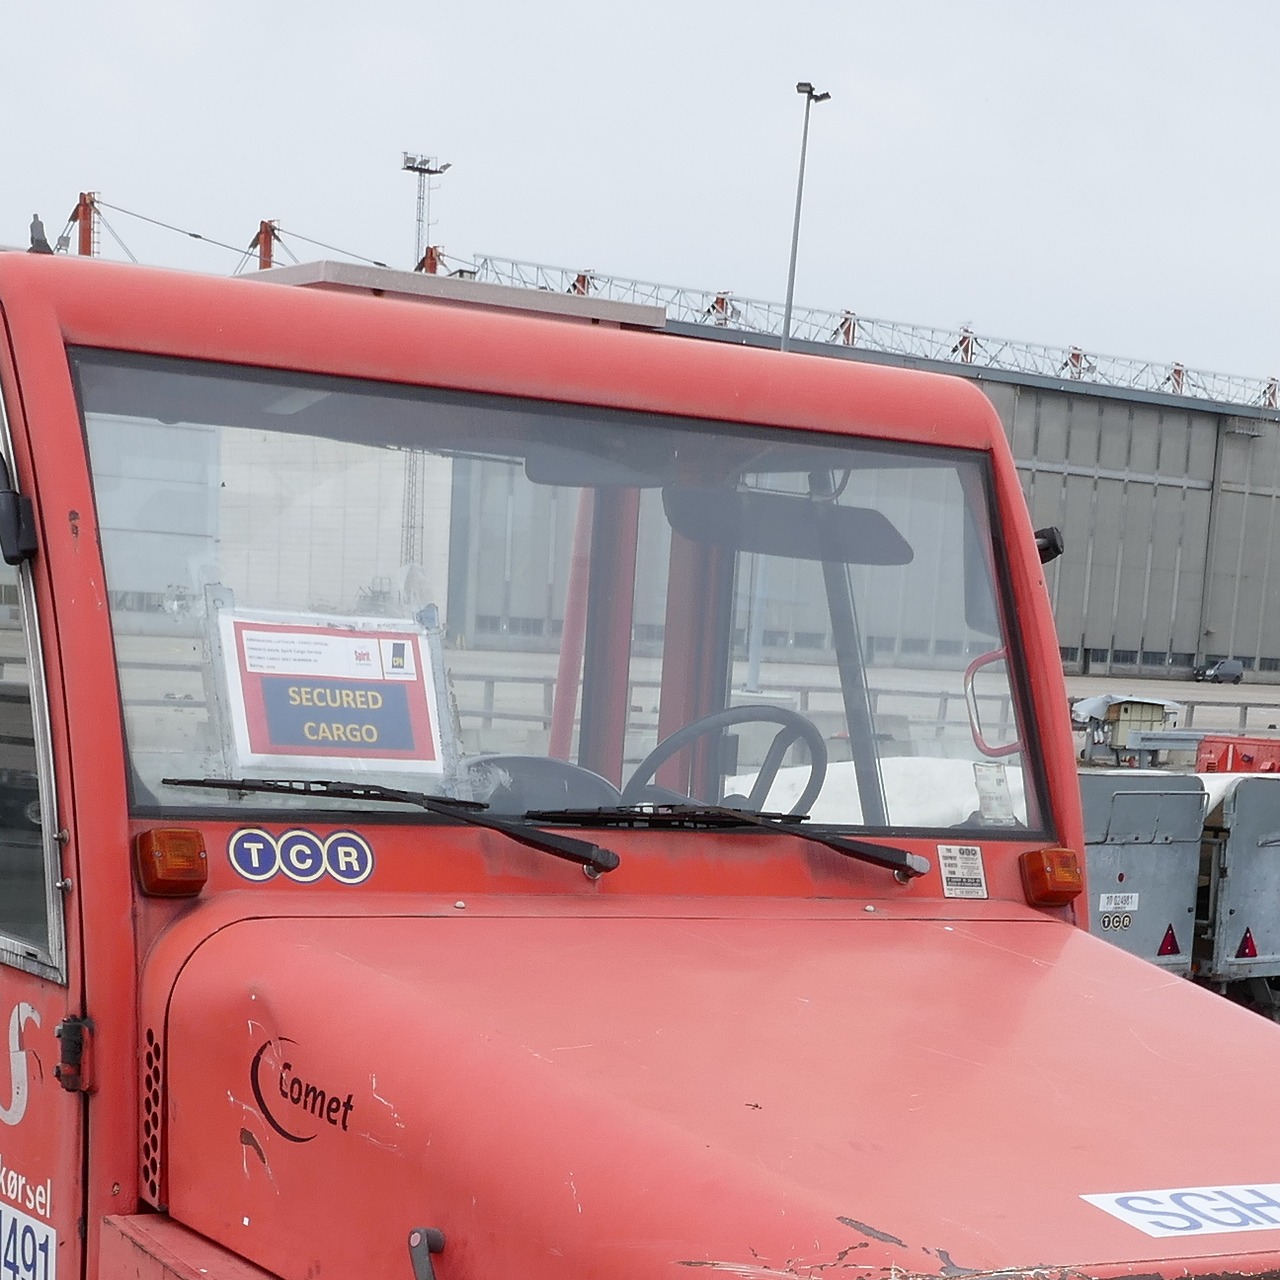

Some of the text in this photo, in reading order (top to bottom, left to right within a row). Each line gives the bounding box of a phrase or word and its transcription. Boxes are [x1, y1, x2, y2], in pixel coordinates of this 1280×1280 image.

[288, 686, 383, 709] SECURED
[303, 721, 378, 743] CARGO
[240, 839, 363, 875] TCR
[1102, 915, 1131, 928] TCR
[279, 1062, 354, 1132] Comet
